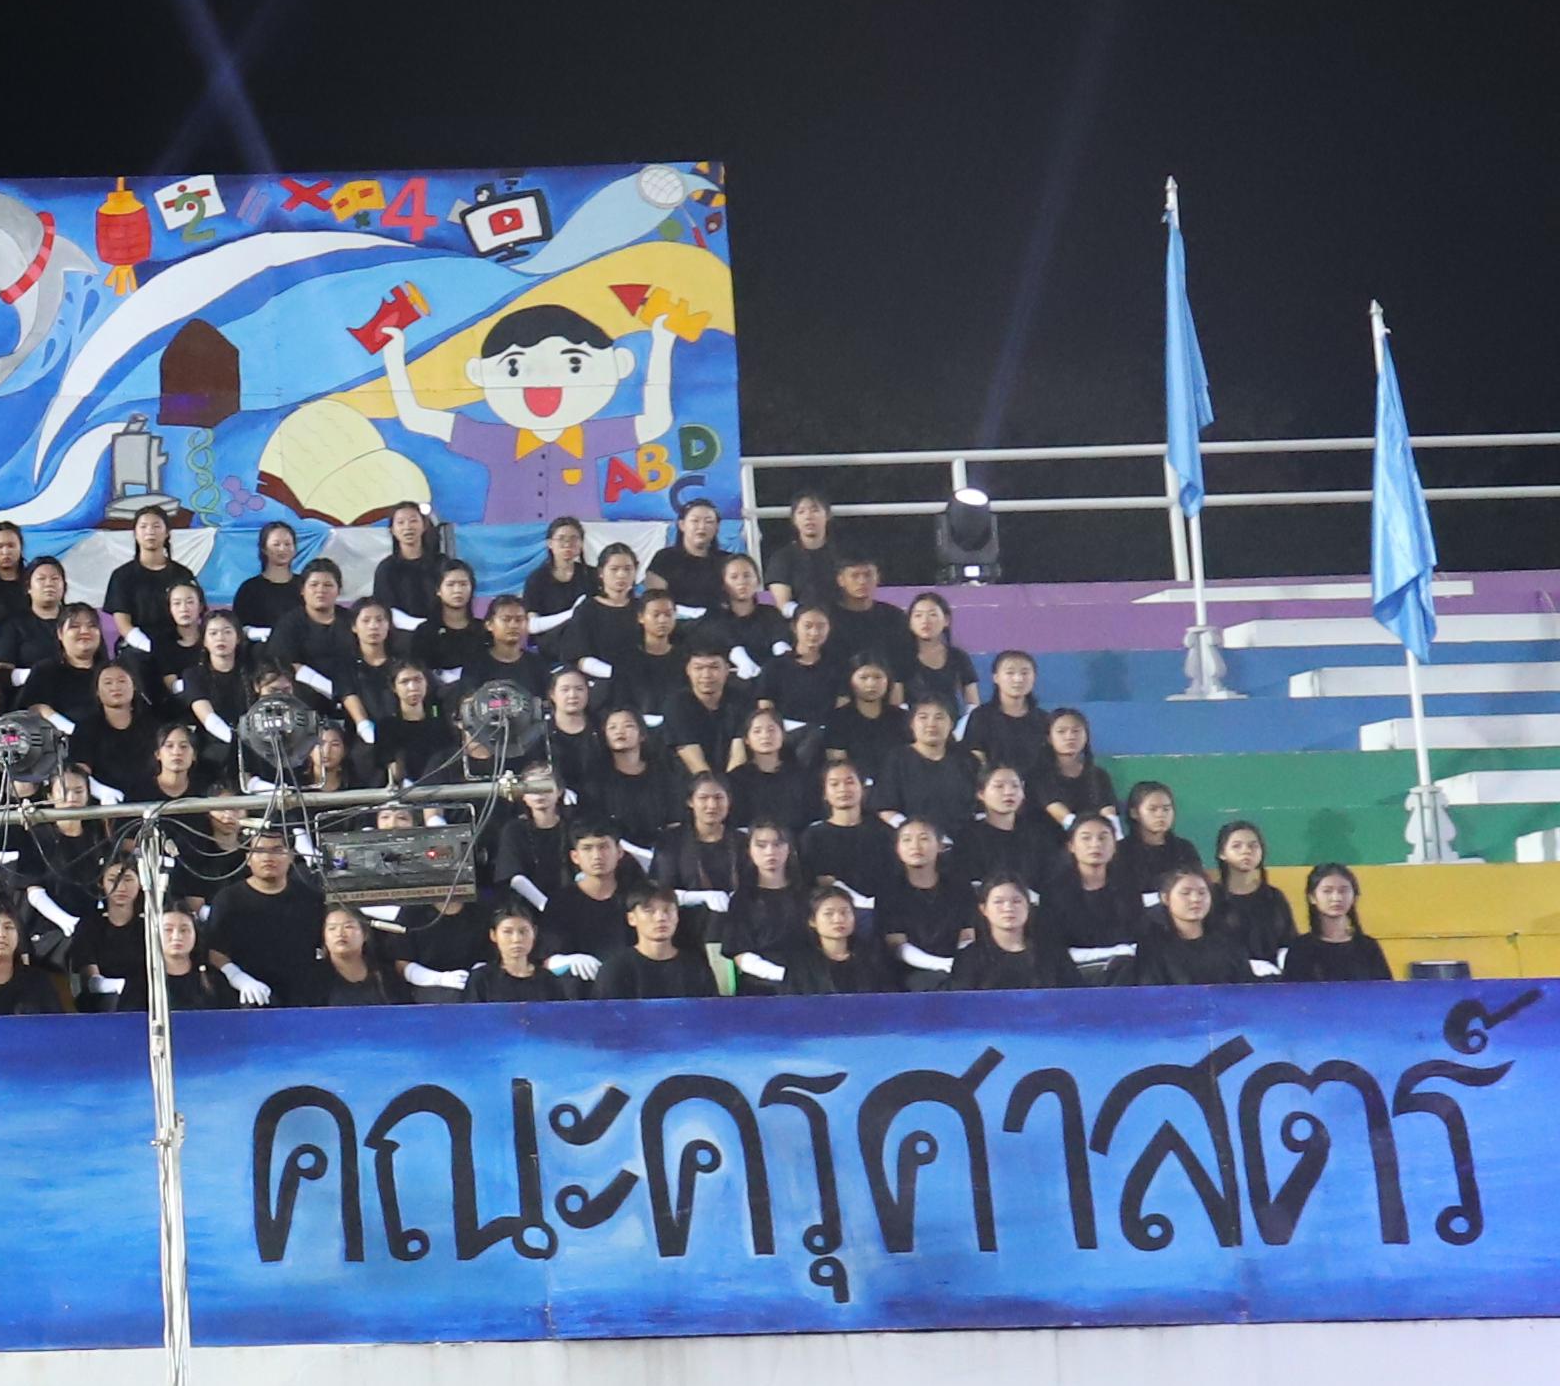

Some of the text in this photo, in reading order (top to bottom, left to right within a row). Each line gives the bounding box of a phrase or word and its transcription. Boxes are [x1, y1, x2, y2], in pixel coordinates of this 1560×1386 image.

[380, 177, 438, 241] 4
[251, 990, 1545, 1304] คณะครุศาสตร์
